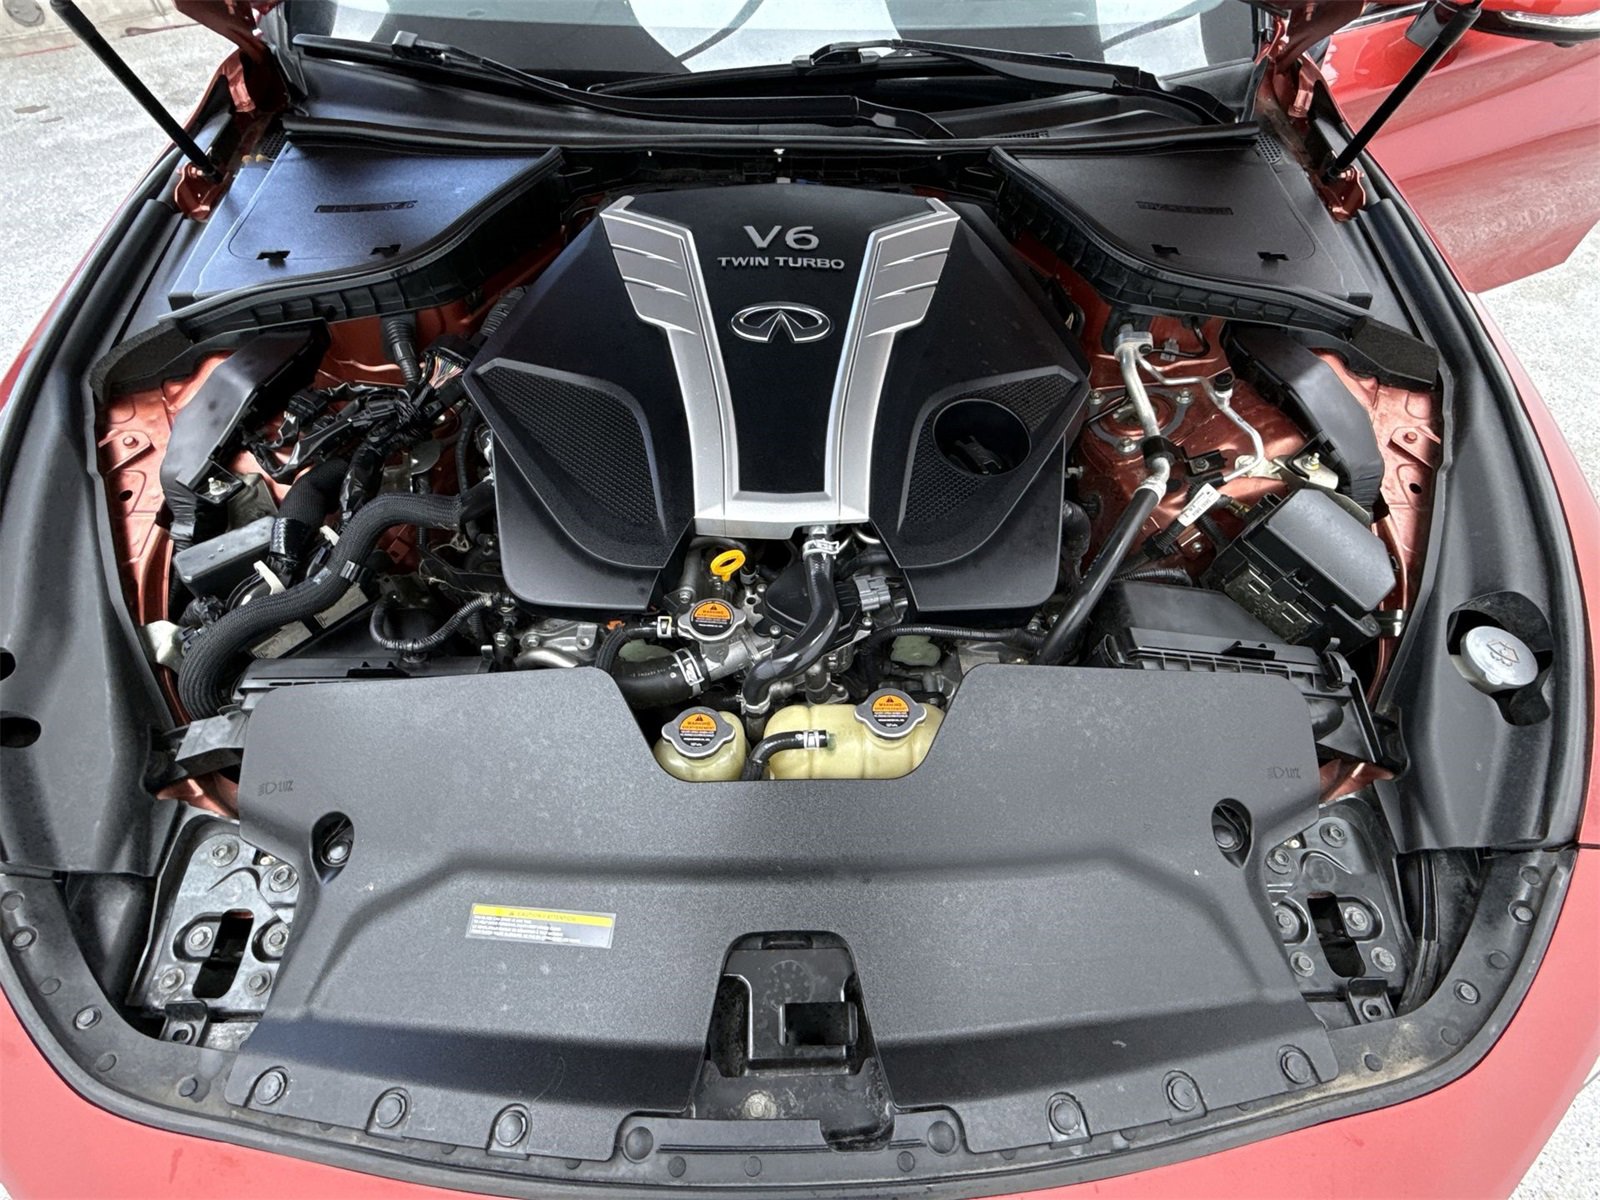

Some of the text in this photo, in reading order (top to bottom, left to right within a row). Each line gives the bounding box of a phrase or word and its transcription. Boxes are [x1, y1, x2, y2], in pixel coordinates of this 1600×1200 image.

[743, 225, 819, 250] V6
[717, 256, 845, 269] TWIN TURBO
